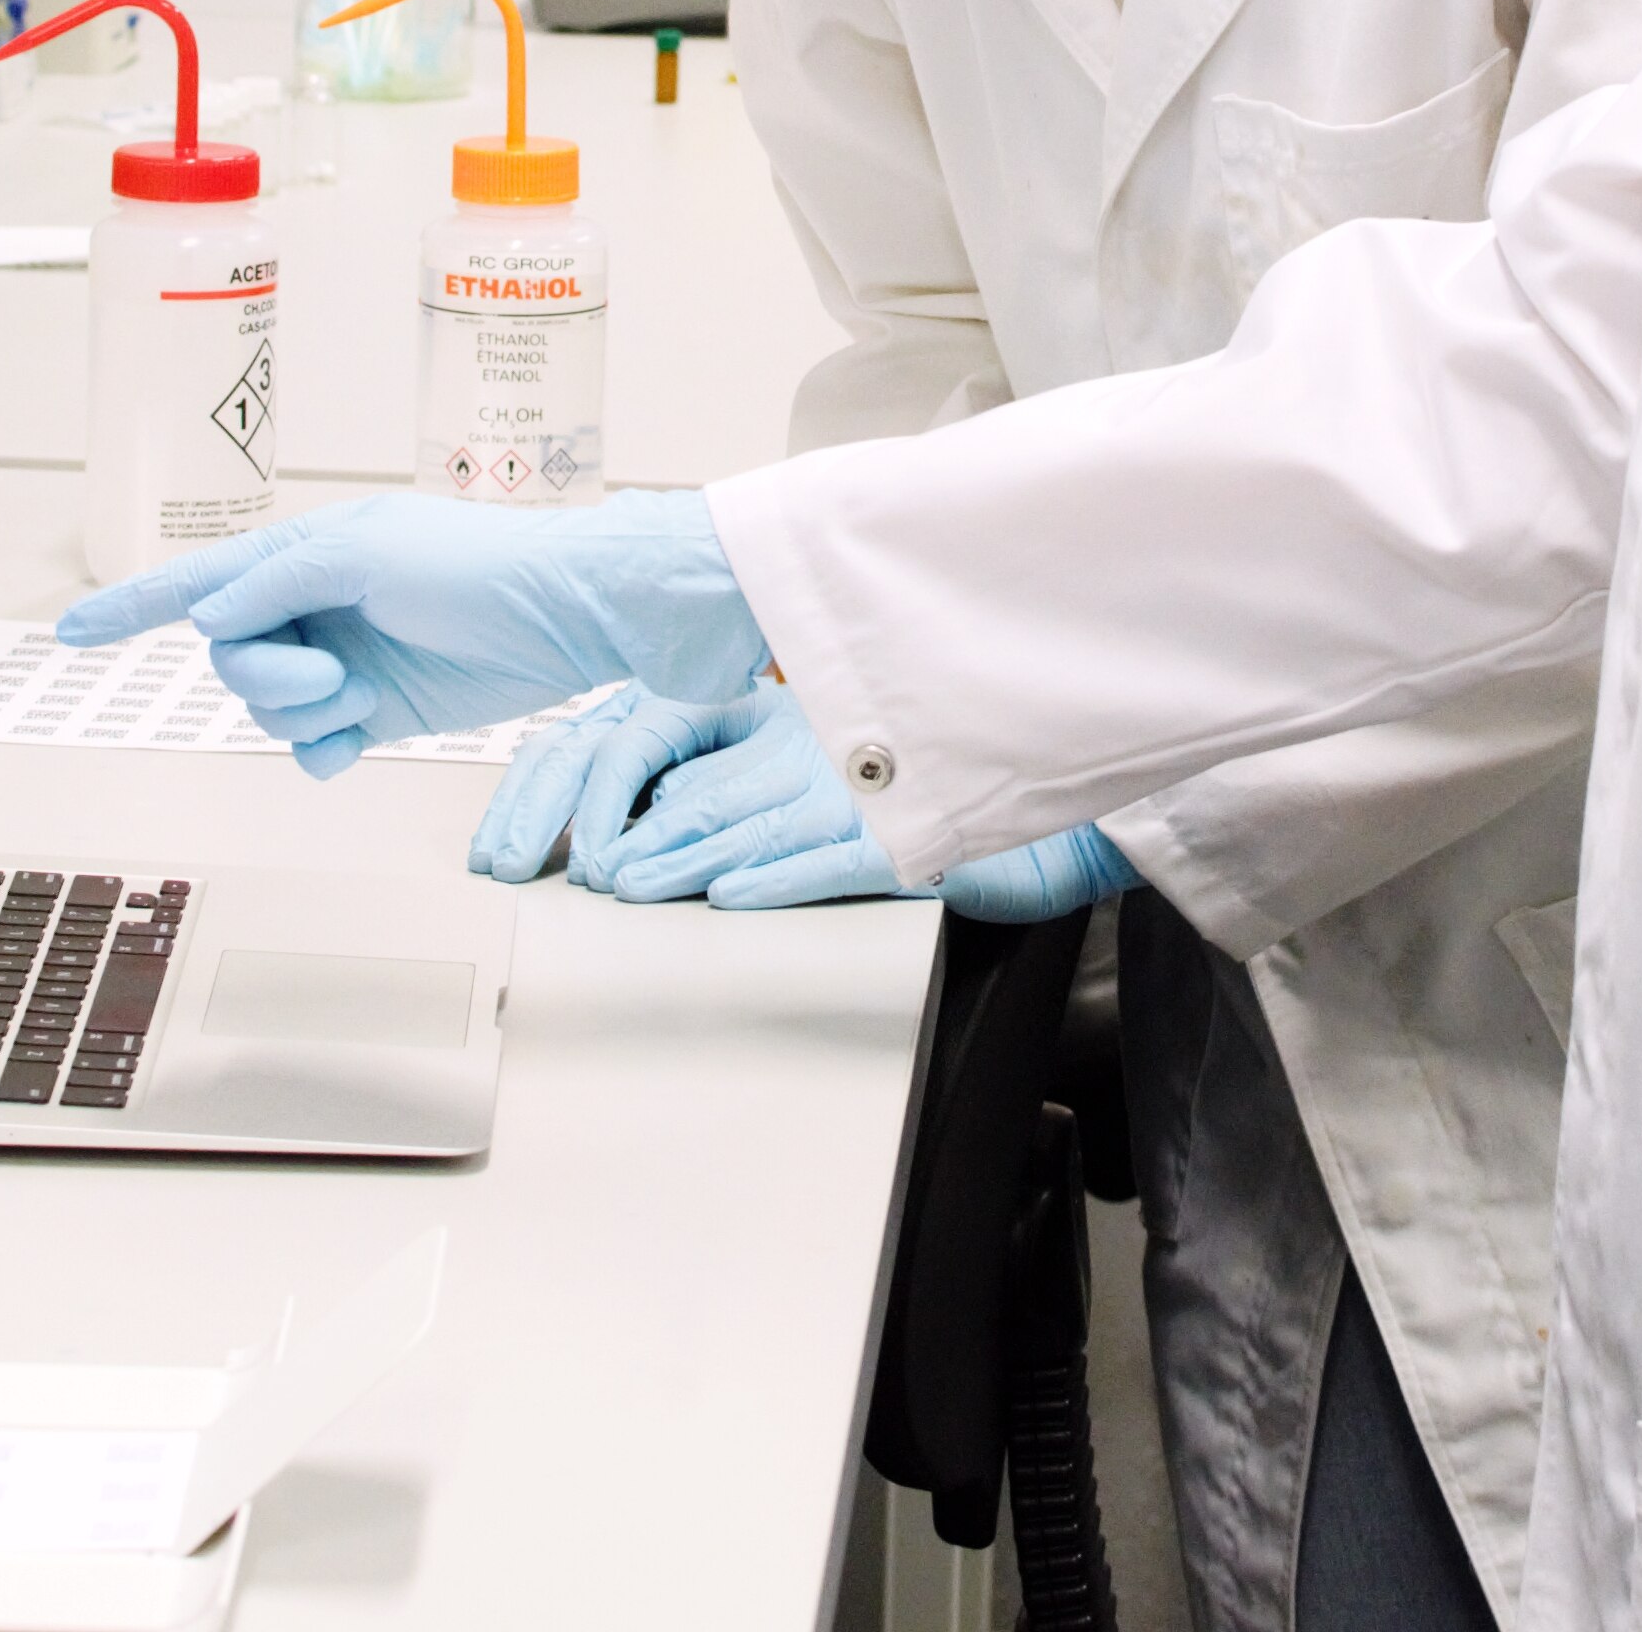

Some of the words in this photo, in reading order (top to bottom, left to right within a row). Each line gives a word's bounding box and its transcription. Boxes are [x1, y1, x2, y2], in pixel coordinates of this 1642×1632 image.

[469, 256, 496, 269] RC
[503, 257, 574, 271] GROUP
[445, 273, 582, 300] ETHANOL
[477, 332, 549, 346] ETHANOL
[476, 348, 549, 364] ÉTHANOL
[259, 357, 271, 391] 3
[482, 369, 542, 383] ETANOL
[234, 397, 247, 430] 1
[468, 433, 489, 443] CAS
[195, 521, 228, 529] STORAGE
